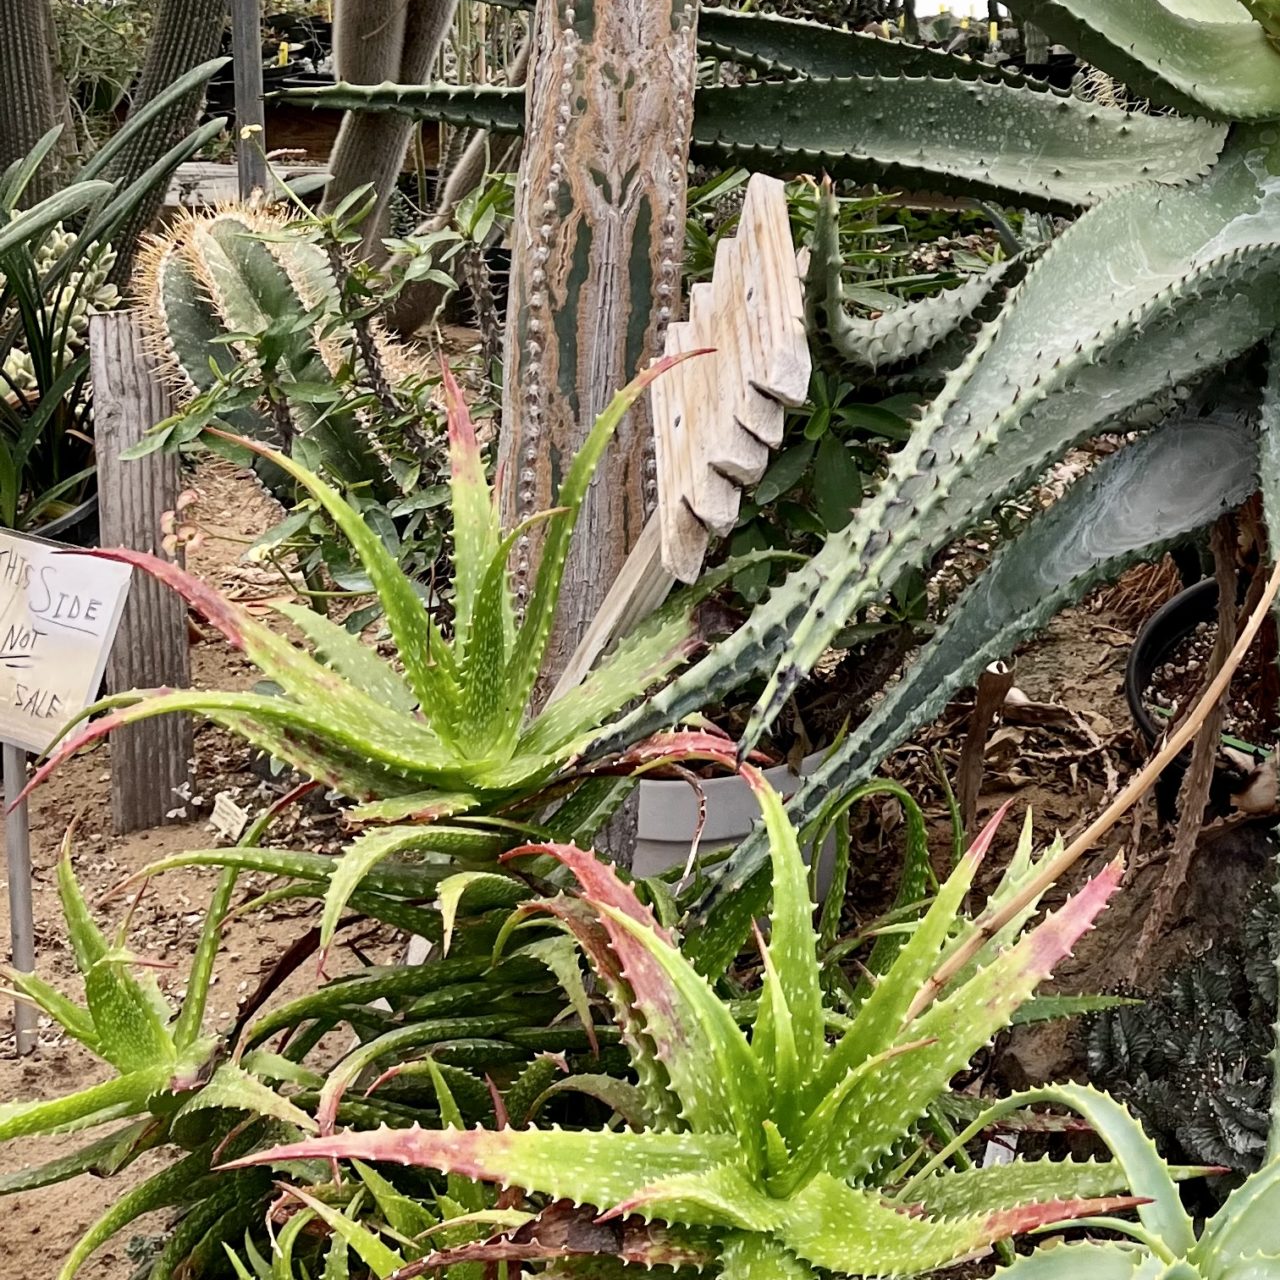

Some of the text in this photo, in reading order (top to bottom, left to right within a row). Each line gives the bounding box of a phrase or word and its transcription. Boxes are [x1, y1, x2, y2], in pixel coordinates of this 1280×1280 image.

[29, 566, 102, 621] SIDE
[0, 624, 48, 652] NOT
[15, 682, 62, 719] SALE
